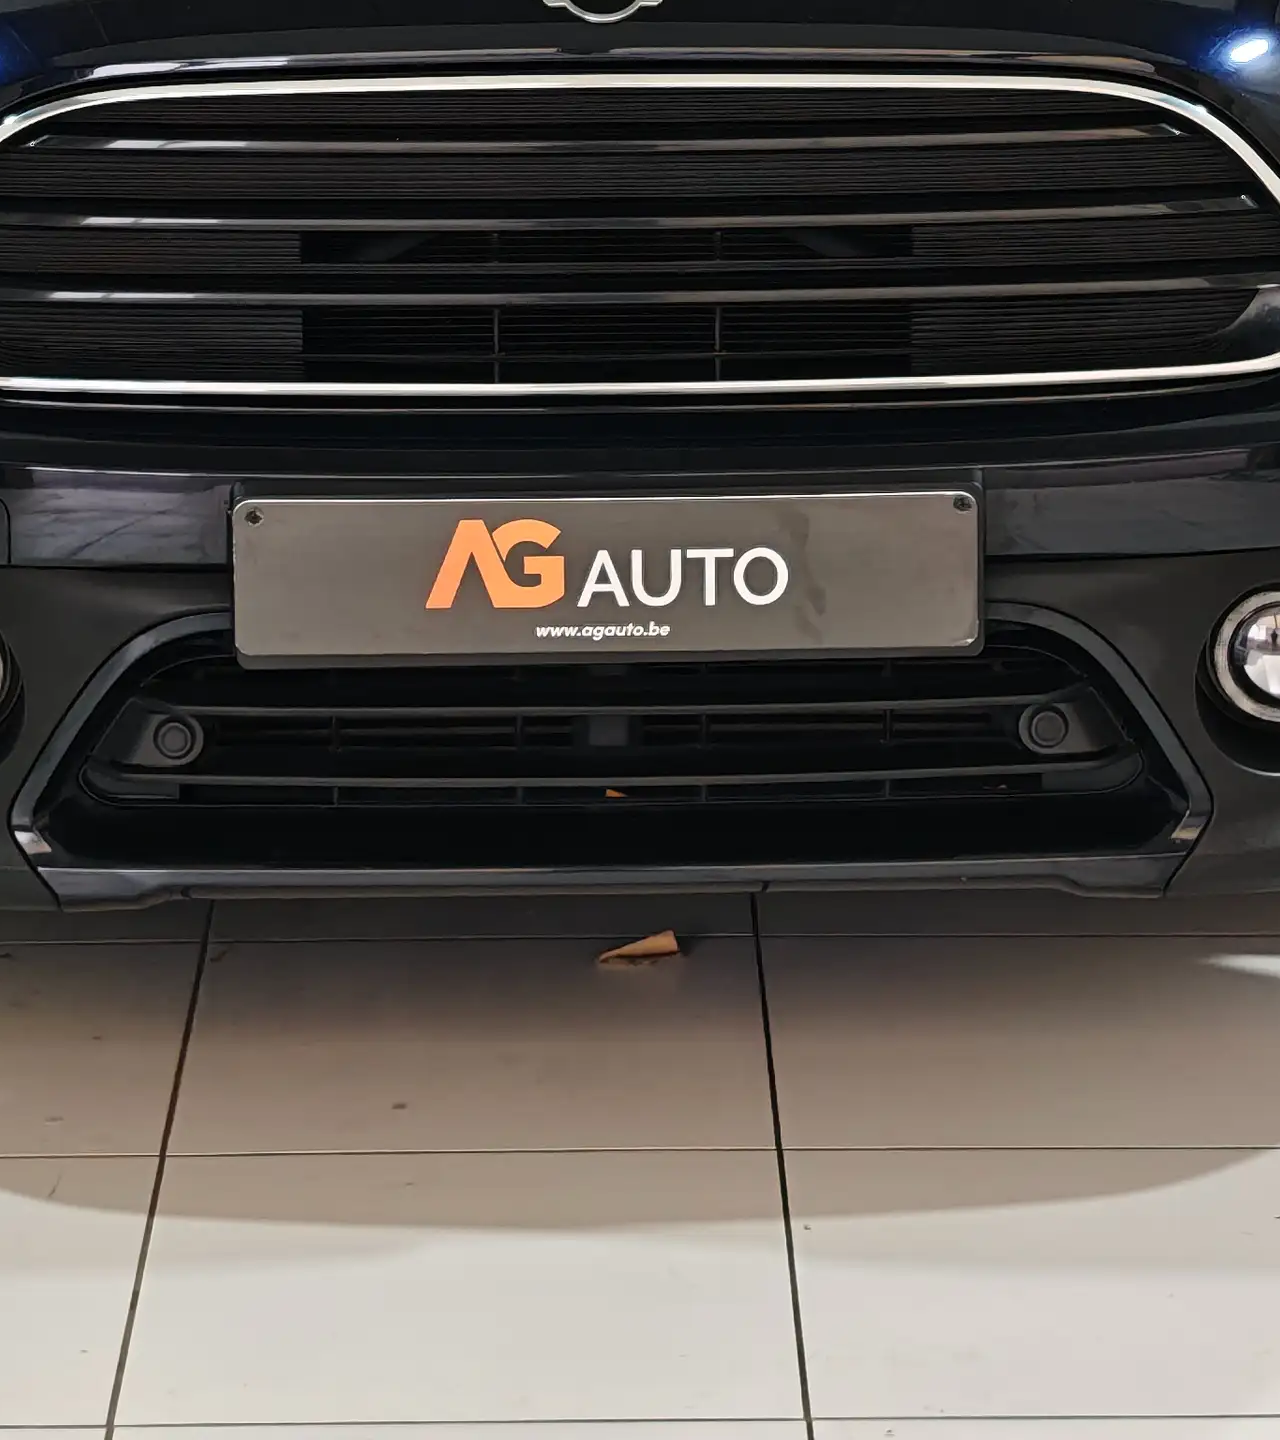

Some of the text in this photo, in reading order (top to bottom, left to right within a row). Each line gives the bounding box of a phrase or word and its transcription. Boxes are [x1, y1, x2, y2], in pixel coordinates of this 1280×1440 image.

[425, 518, 789, 609] AG AUTO
[535, 620, 671, 641] www.agauto.be
